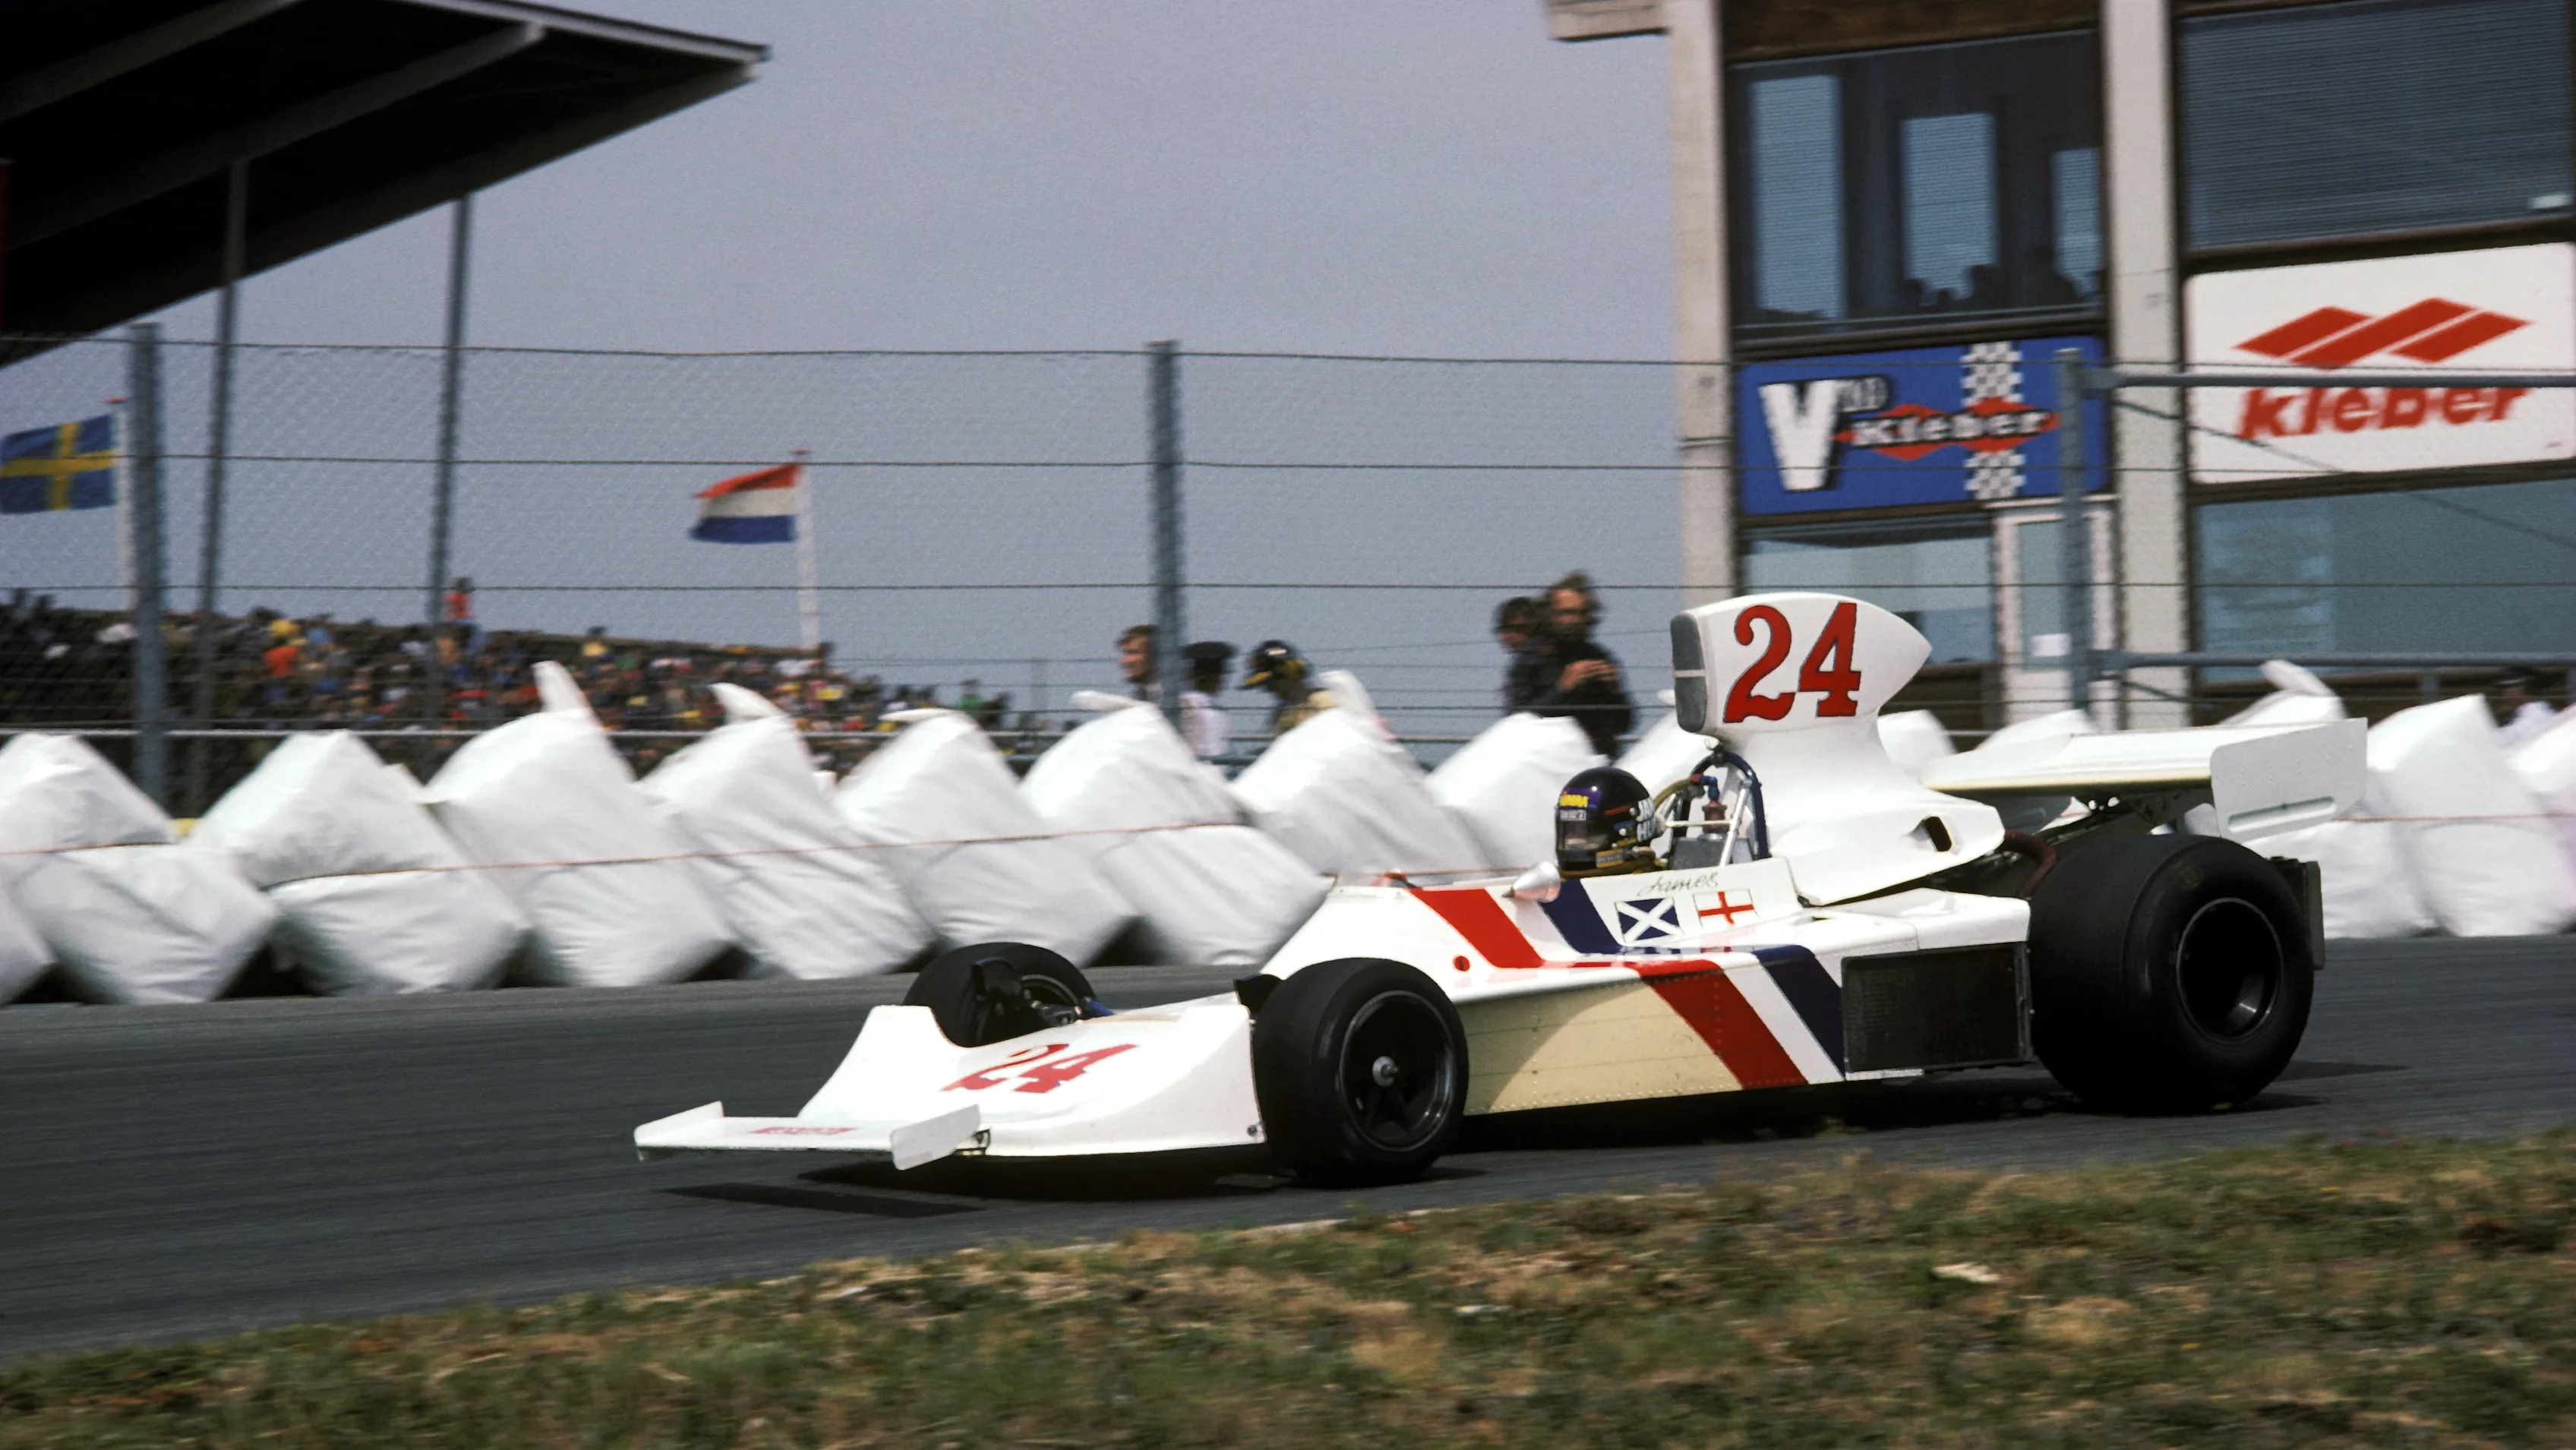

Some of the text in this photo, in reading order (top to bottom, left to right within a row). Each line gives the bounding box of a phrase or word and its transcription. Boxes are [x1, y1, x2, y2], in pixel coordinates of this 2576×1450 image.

[1722, 602, 1861, 724] 24
[1637, 871, 1719, 897] James
[939, 1043, 1141, 1094] 24
